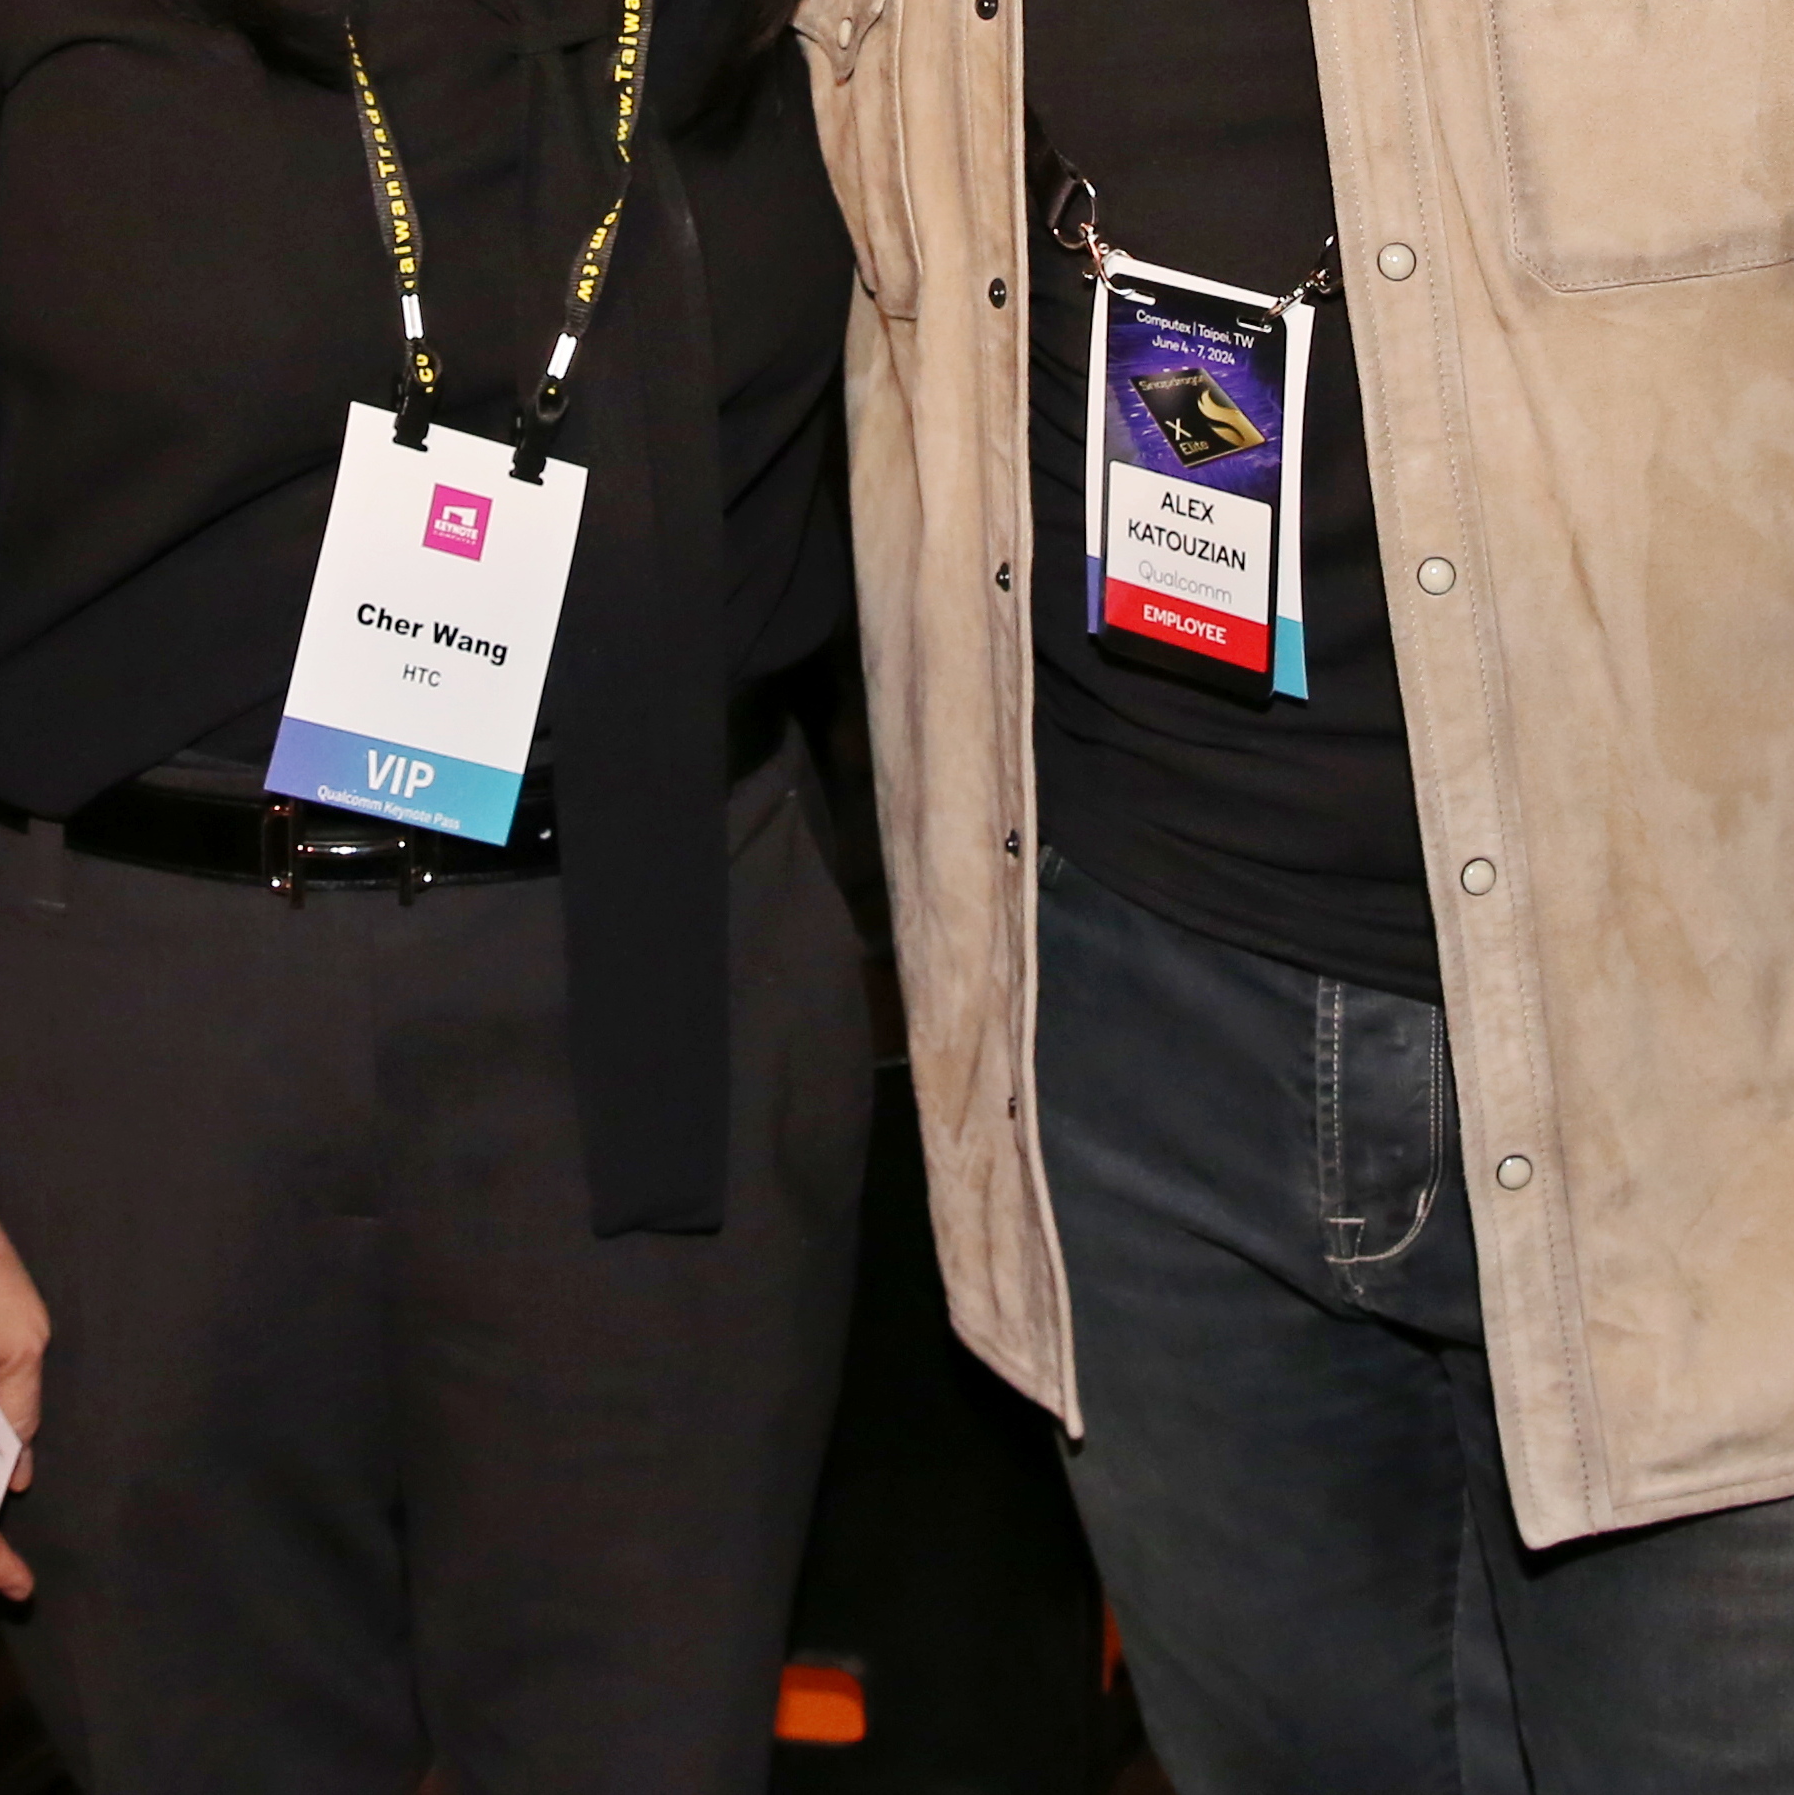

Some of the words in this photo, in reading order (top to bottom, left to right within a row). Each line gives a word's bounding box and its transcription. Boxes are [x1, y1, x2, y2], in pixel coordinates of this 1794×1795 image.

[1135, 309, 1191, 335] Computex
[1198, 323, 1232, 345] Taipei,
[1233, 332, 1255, 349] TW
[1152, 334, 1180, 352] June
[1180, 340, 1189, 354] 4
[1197, 344, 1207, 360] 7,
[1207, 347, 1237, 366] 2024
[1165, 417, 1193, 442] X
[1179, 440, 1210, 456] Elite
[1160, 491, 1215, 525] ALEX
[1128, 518, 1247, 572] KATOUZIAN
[1138, 560, 1233, 605] Qualcomm
[357, 603, 424, 638] Cher
[433, 621, 509, 667] Wang
[1142, 603, 1228, 645] EMPLOYEE
[402, 663, 442, 688] HTC
[367, 749, 435, 799] VIP
[317, 784, 383, 812] Qualcomm
[383, 800, 433, 824] Keynote
[432, 811, 461, 831] Pass
